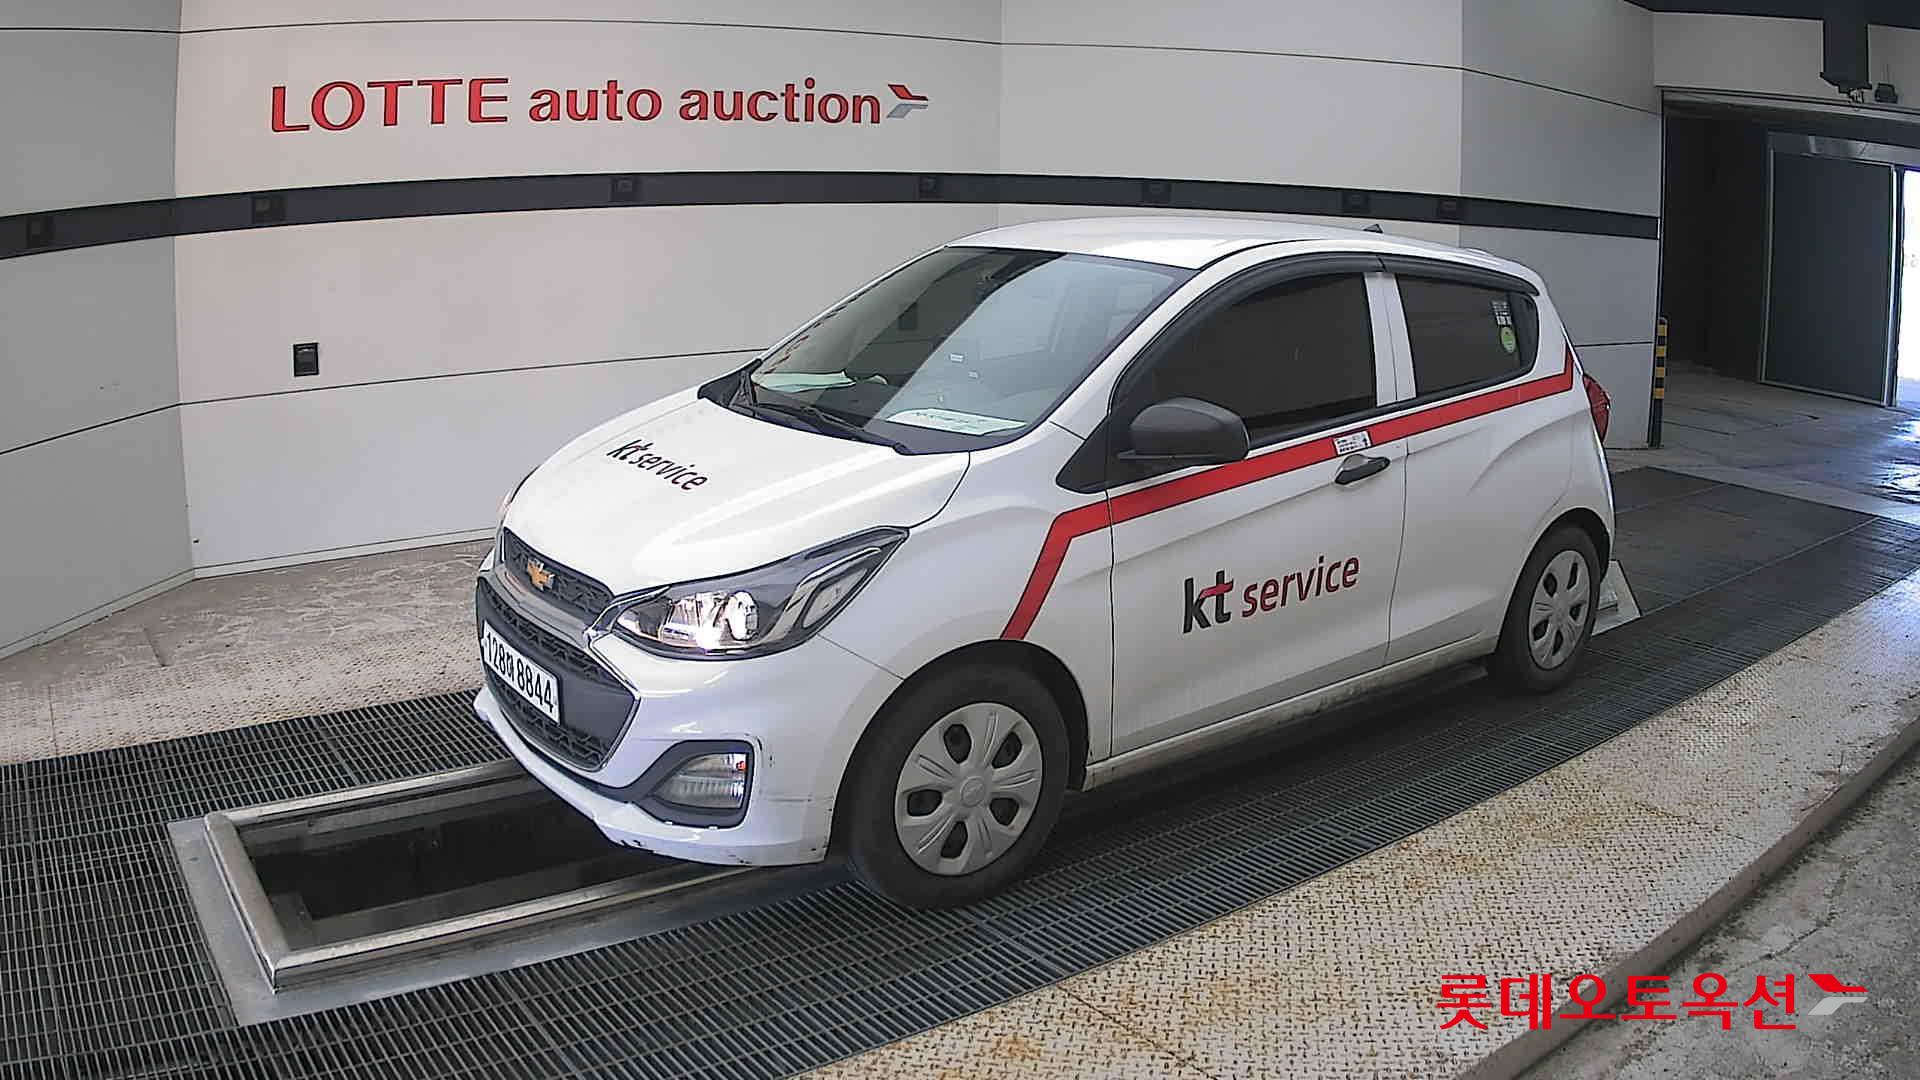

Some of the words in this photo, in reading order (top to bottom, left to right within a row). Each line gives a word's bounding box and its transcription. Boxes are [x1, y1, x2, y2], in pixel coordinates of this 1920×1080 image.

[271, 78, 508, 133] LOTTE
[528, 80, 663, 123] auto
[678, 77, 881, 125] auction
[606, 439, 654, 460] kt
[628, 453, 708, 490] service
[1183, 570, 1234, 634] kt
[1242, 555, 1360, 617] service
[517, 658, 554, 713] 8844
